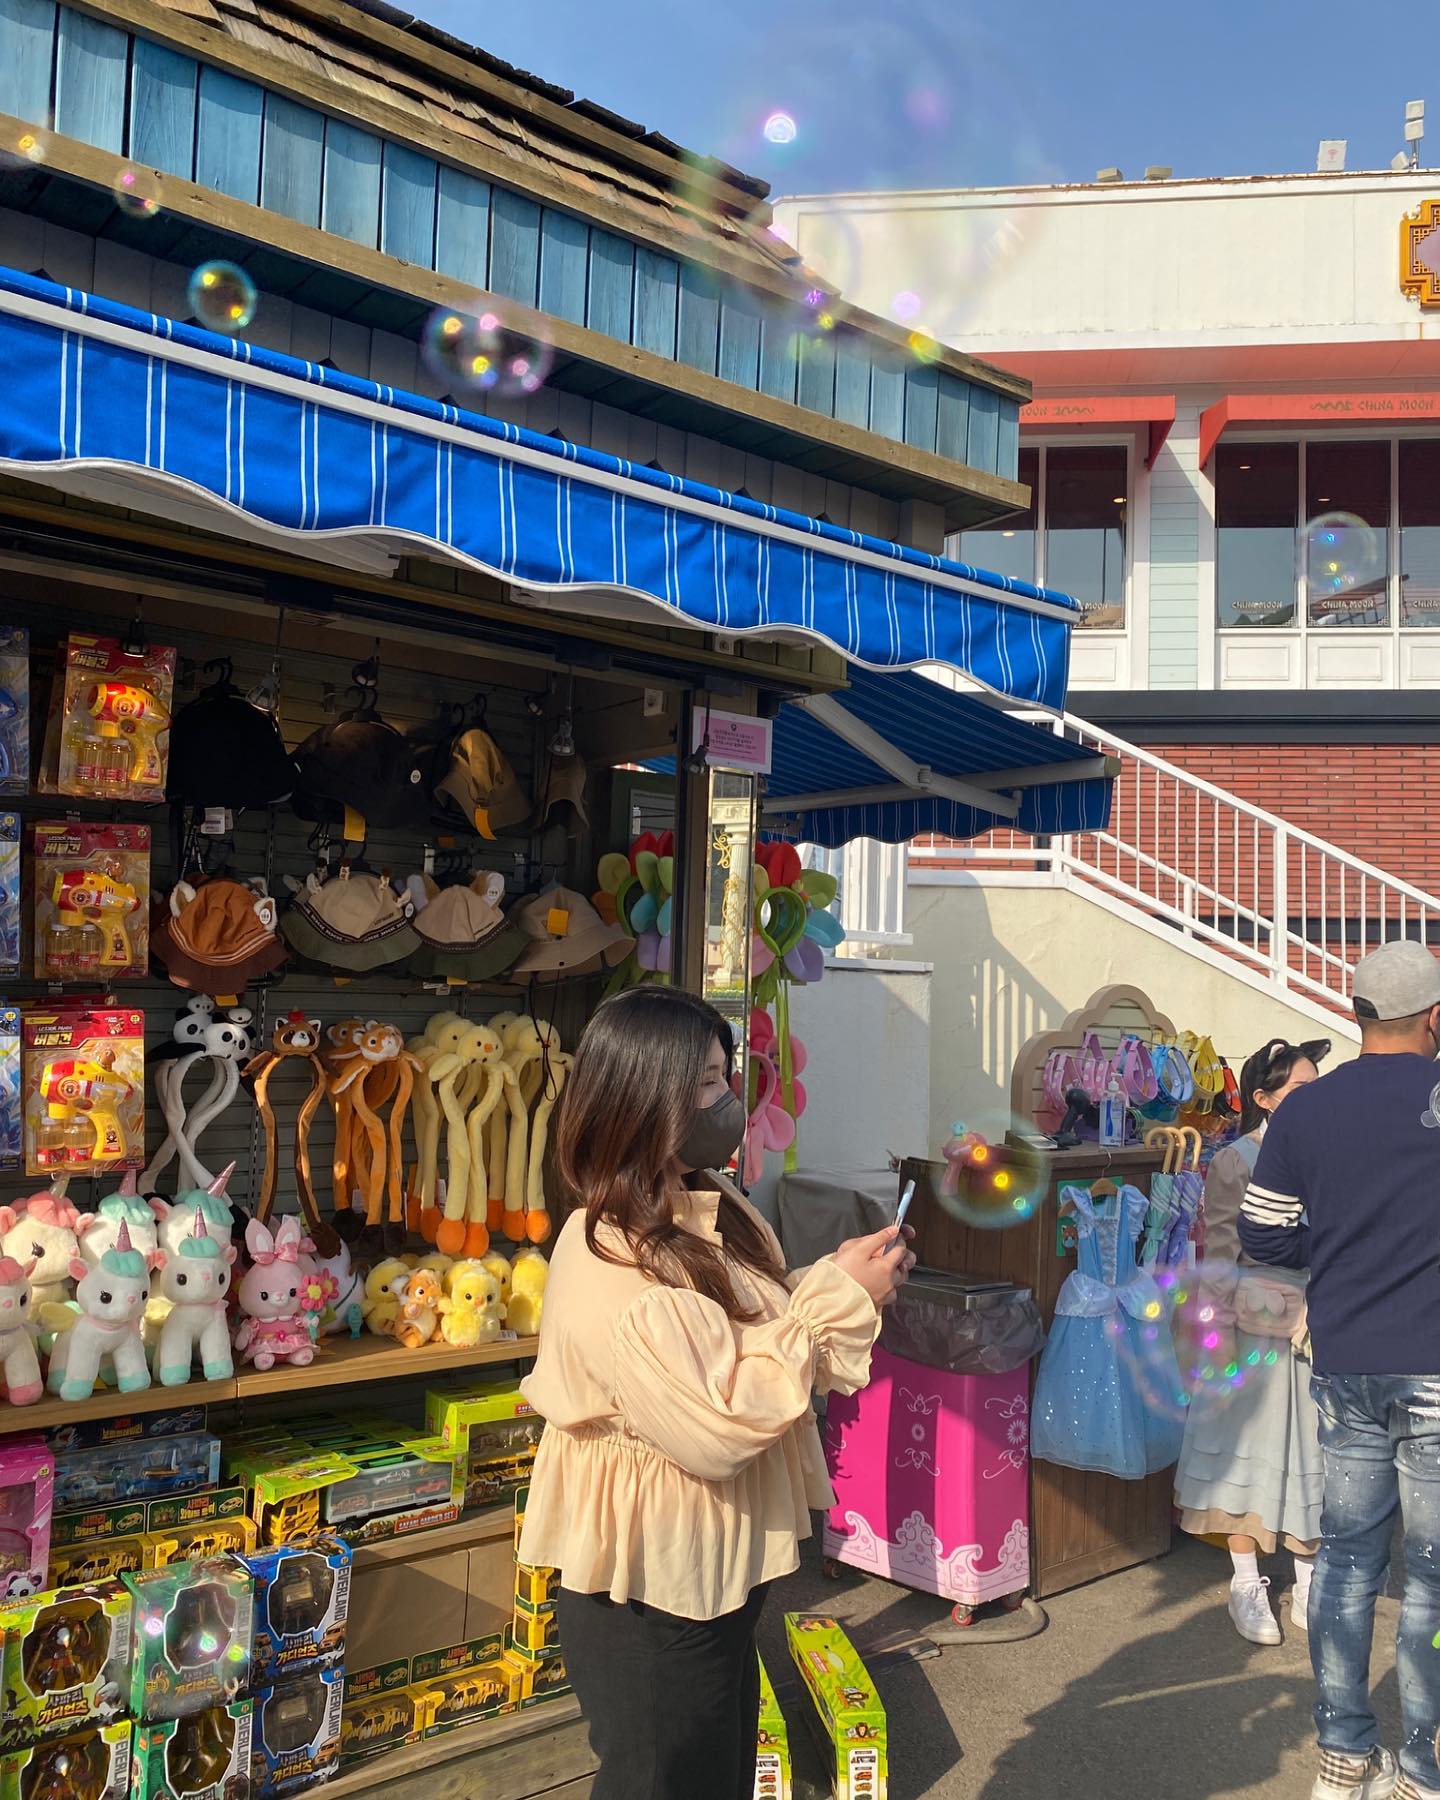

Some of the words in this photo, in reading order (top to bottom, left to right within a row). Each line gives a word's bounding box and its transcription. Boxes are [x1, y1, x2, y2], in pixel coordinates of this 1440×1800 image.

[1360, 400, 1393, 410] CHINA
[1400, 399, 1434, 410] MOON
[1259, 600, 1282, 609] MOON
[1322, 600, 1347, 609] CHINA
[1350, 600, 1374, 608] MOON
[334, 1567, 349, 1620] EVERLAND
[286, 1632, 313, 1648] 사파리
[276, 1643, 319, 1665] 가디언즈
[175, 1673, 219, 1696] 가디언즈
[48, 1687, 83, 1707] 사파리
[37, 1700, 90, 1726] 가디언즈
[328, 1682, 342, 1735] EVERLAND
[280, 1750, 308, 1766] 사파리
[271, 1759, 314, 1784] 가디언즈
